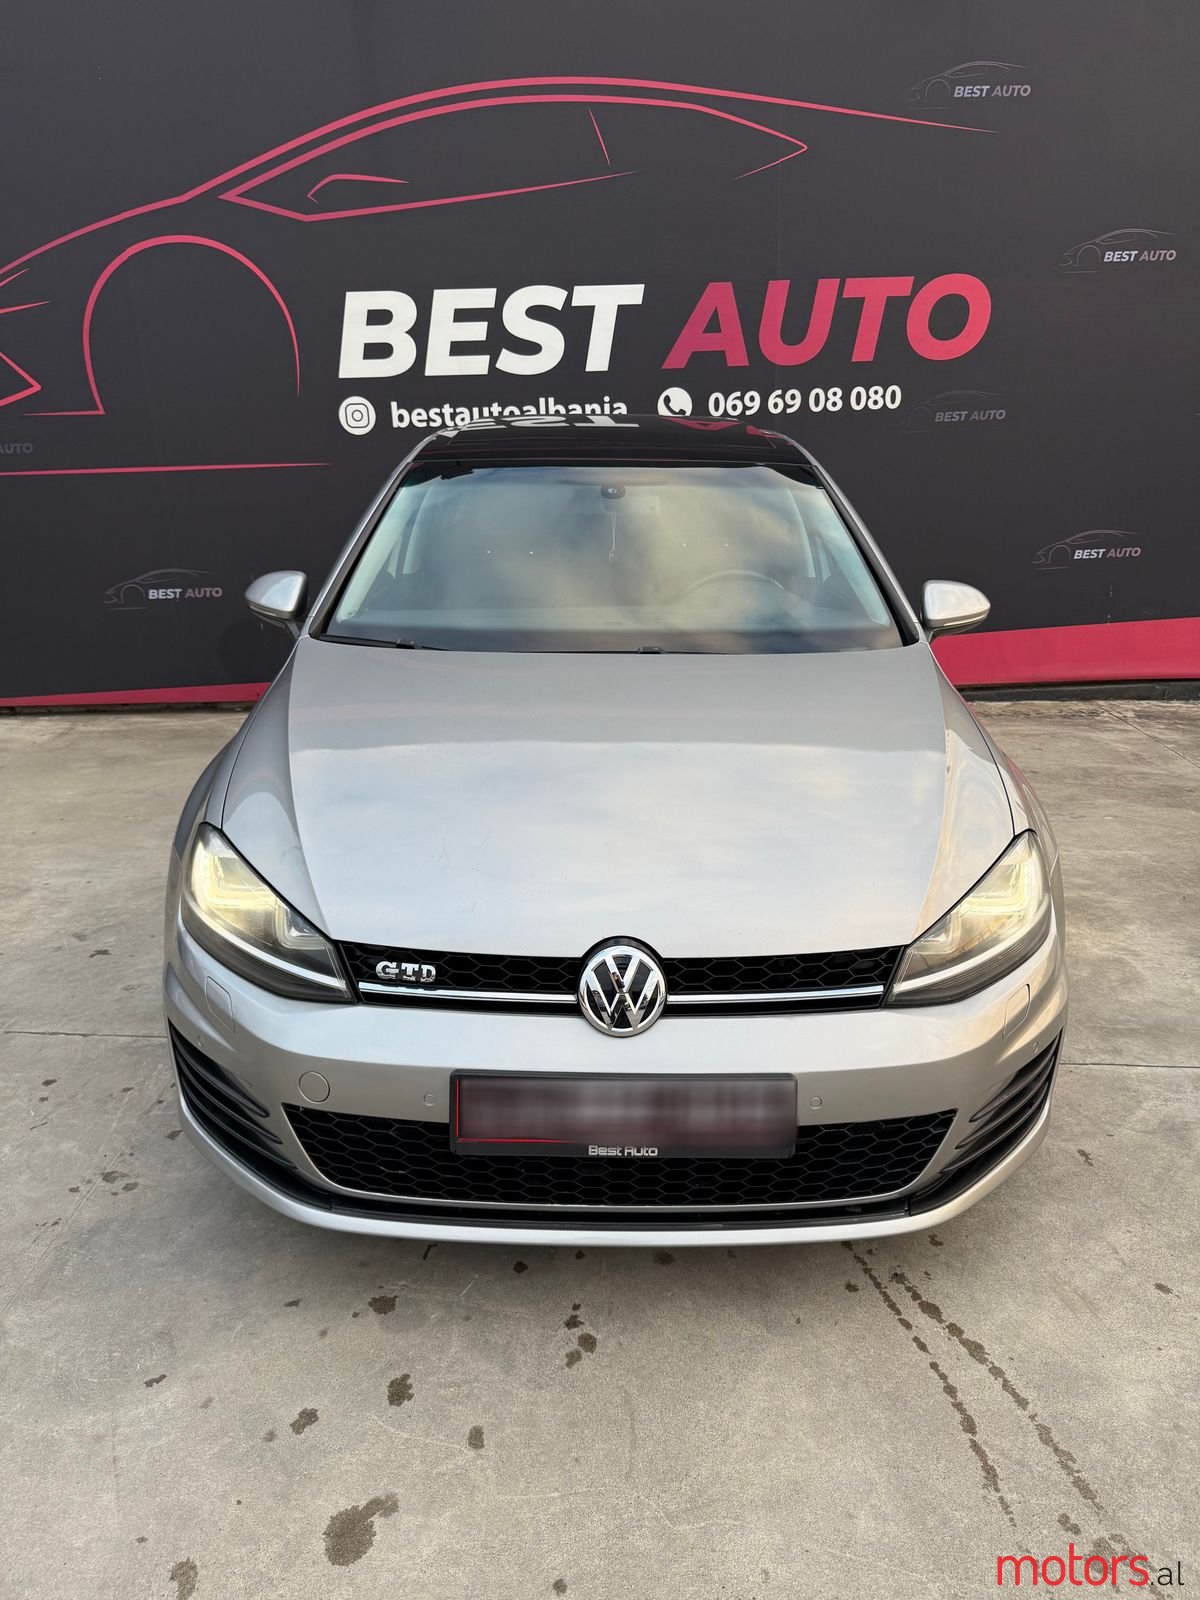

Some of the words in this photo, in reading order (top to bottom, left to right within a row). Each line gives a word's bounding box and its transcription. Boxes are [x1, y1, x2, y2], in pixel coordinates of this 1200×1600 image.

[953, 85, 990, 98] BEST
[991, 84, 1031, 97] AUTO
[1103, 250, 1138, 262] BEST
[1138, 249, 1177, 261] AUTO
[338, 283, 646, 379] BEST
[661, 273, 992, 369] AUTO
[708, 391, 761, 417] 069
[767, 388, 801, 415] 69
[808, 387, 843, 412] 08
[849, 384, 902, 411] 080
[934, 410, 968, 422] BEST
[969, 409, 1006, 421] AUTO
[1073, 548, 1106, 560] BEST
[1106, 546, 1141, 558] AUTO
[148, 588, 182, 600] BEST
[184, 587, 223, 599] AUTO
[375, 960, 437, 983] GTD
[588, 1144, 623, 1157] Best
[624, 1146, 658, 1157] Auto
